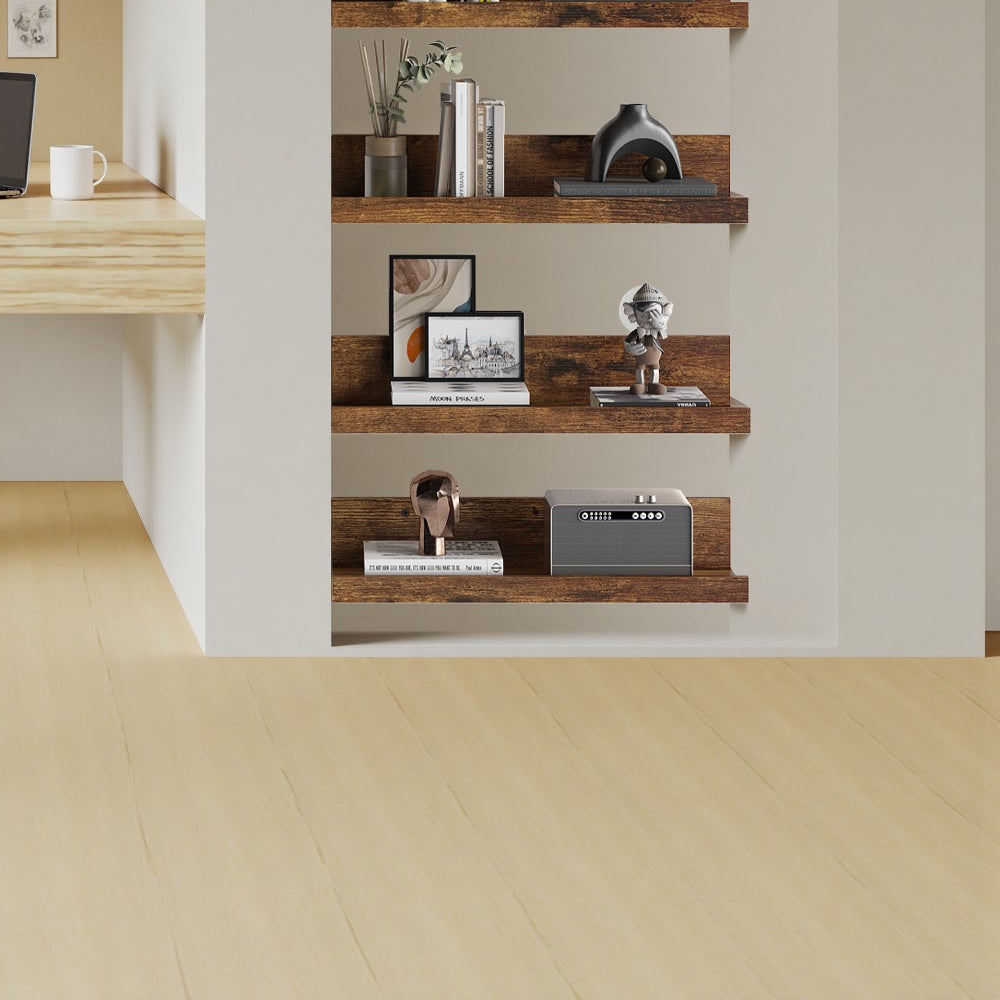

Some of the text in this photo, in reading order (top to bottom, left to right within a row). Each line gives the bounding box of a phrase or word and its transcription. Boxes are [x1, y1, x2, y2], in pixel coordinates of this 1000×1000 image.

[486, 126, 494, 194] SCHOOL OF FASHION
